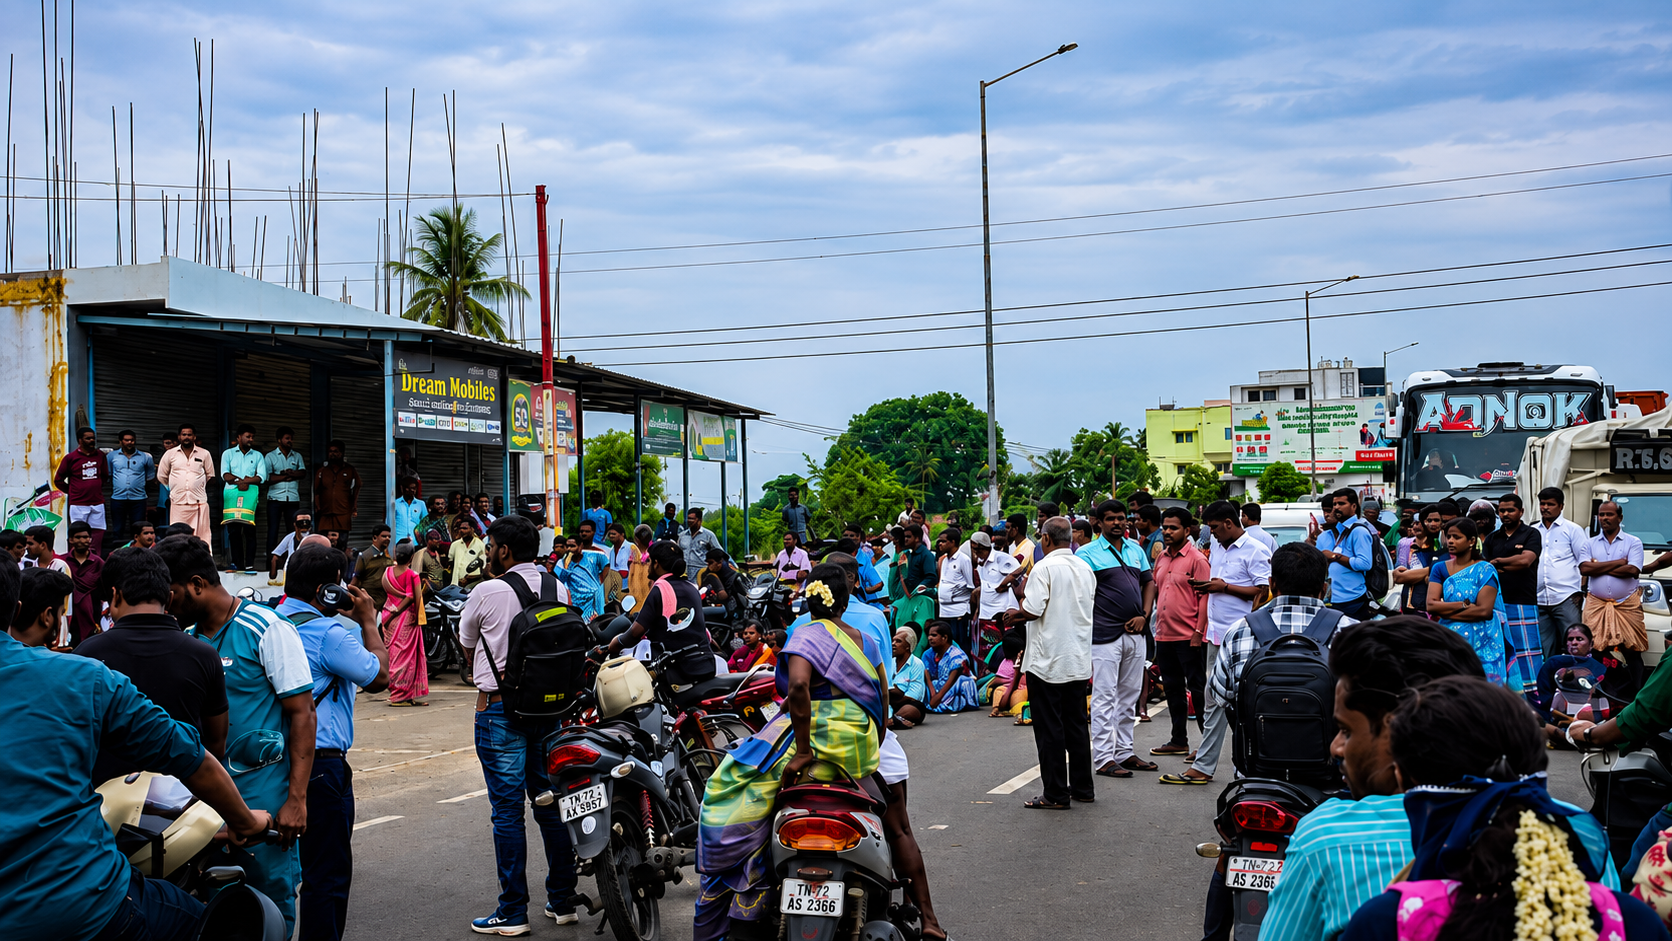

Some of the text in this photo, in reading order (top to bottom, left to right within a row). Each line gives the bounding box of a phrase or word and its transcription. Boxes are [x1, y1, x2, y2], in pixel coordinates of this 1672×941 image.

[401, 371, 446, 397] Dream
[449, 376, 495, 402] Mobiles
[1233, 873, 1246, 886] AS
[787, 897, 836, 913] AS 2366
